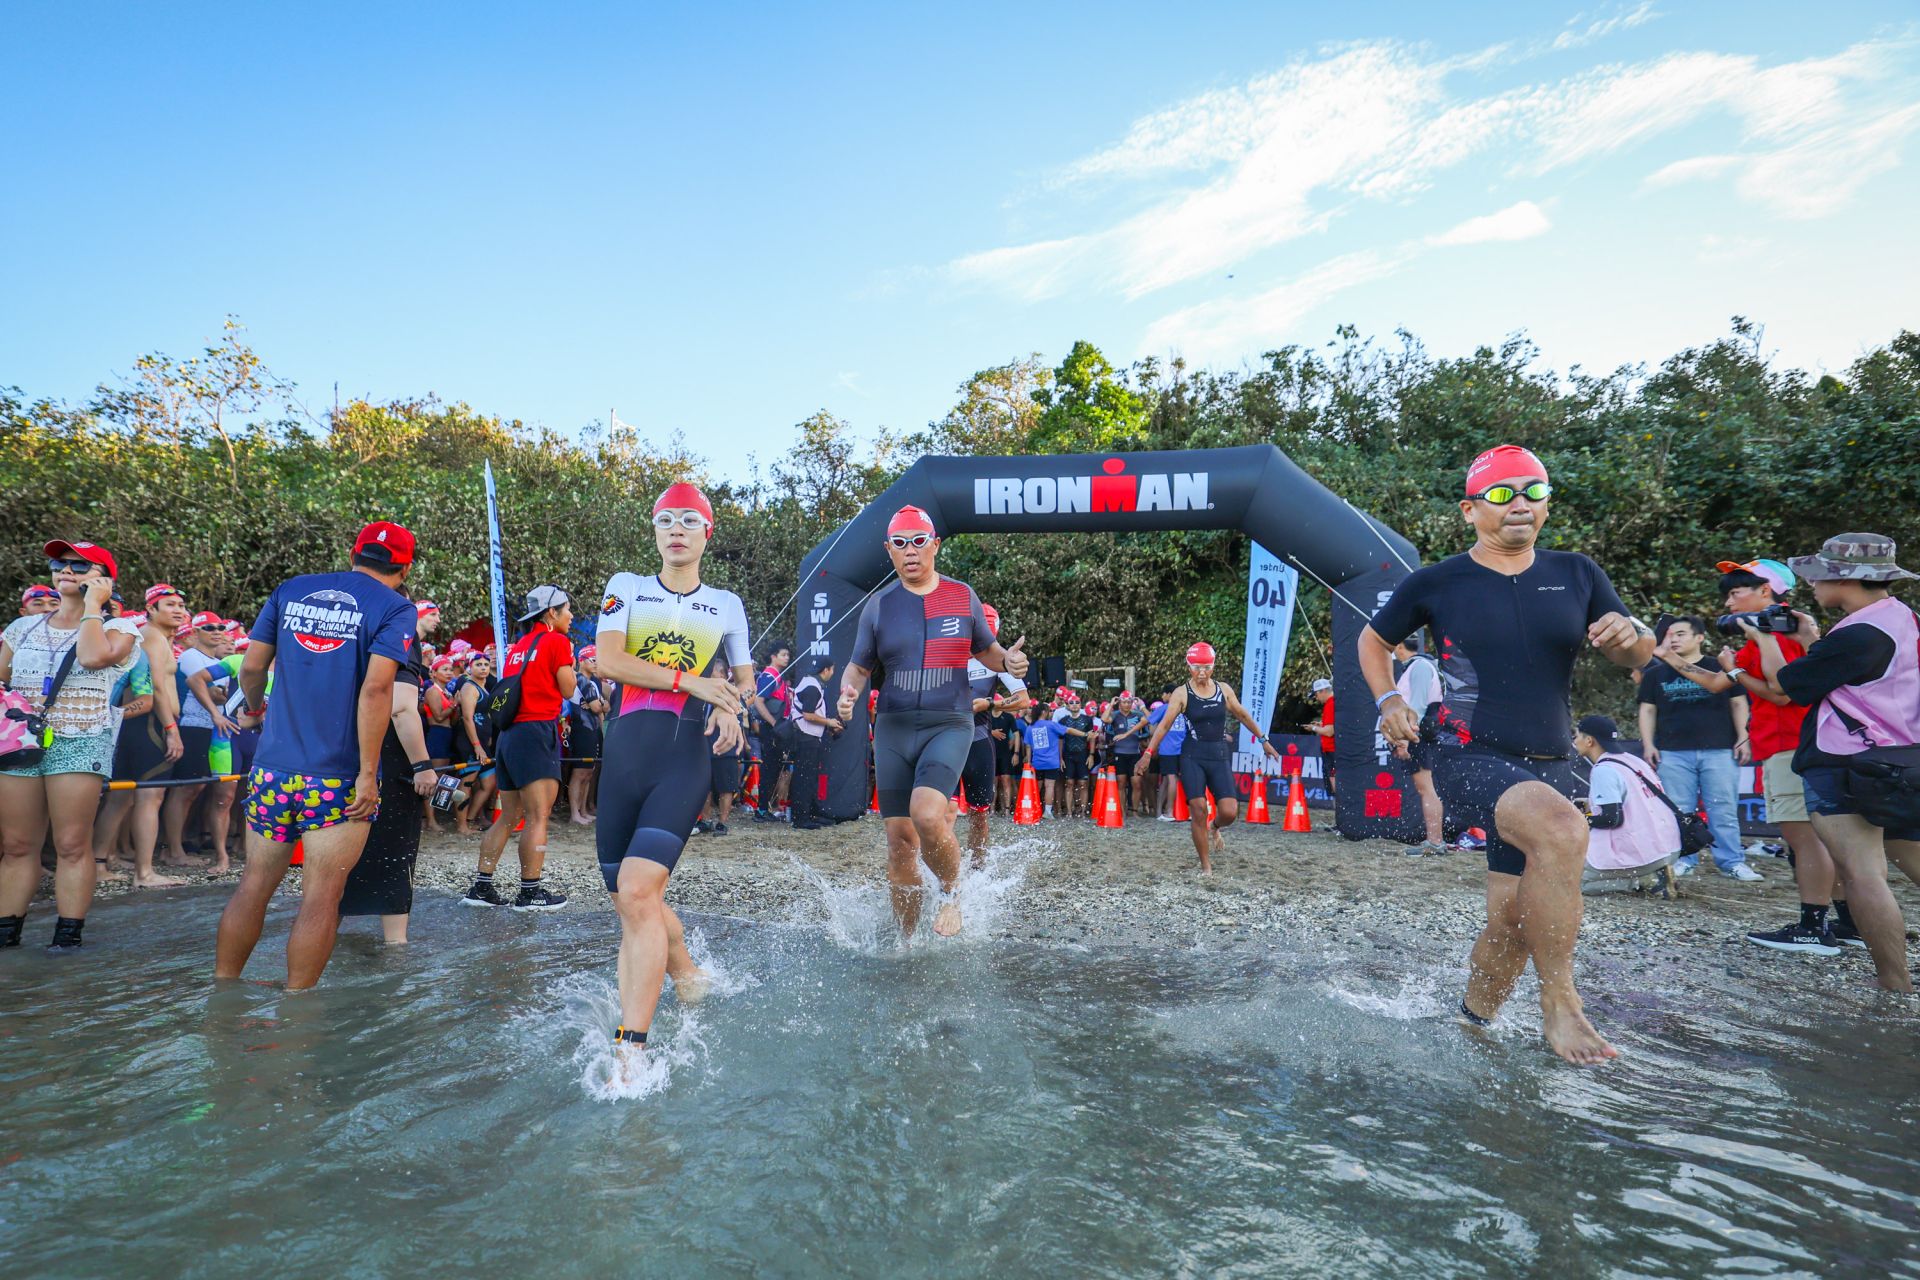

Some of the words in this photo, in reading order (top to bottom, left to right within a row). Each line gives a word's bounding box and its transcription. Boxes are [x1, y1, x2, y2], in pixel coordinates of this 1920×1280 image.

[975, 458, 1209, 514] IRONMAN
[635, 595, 665, 603] Santini
[691, 602, 718, 615] STC
[283, 615, 314, 633] 70.3
[317, 620, 347, 632] TAIWAN
[284, 601, 364, 626] IRONMAN
[810, 592, 831, 656] SWIM
[1231, 745, 1324, 779] IRONMA
